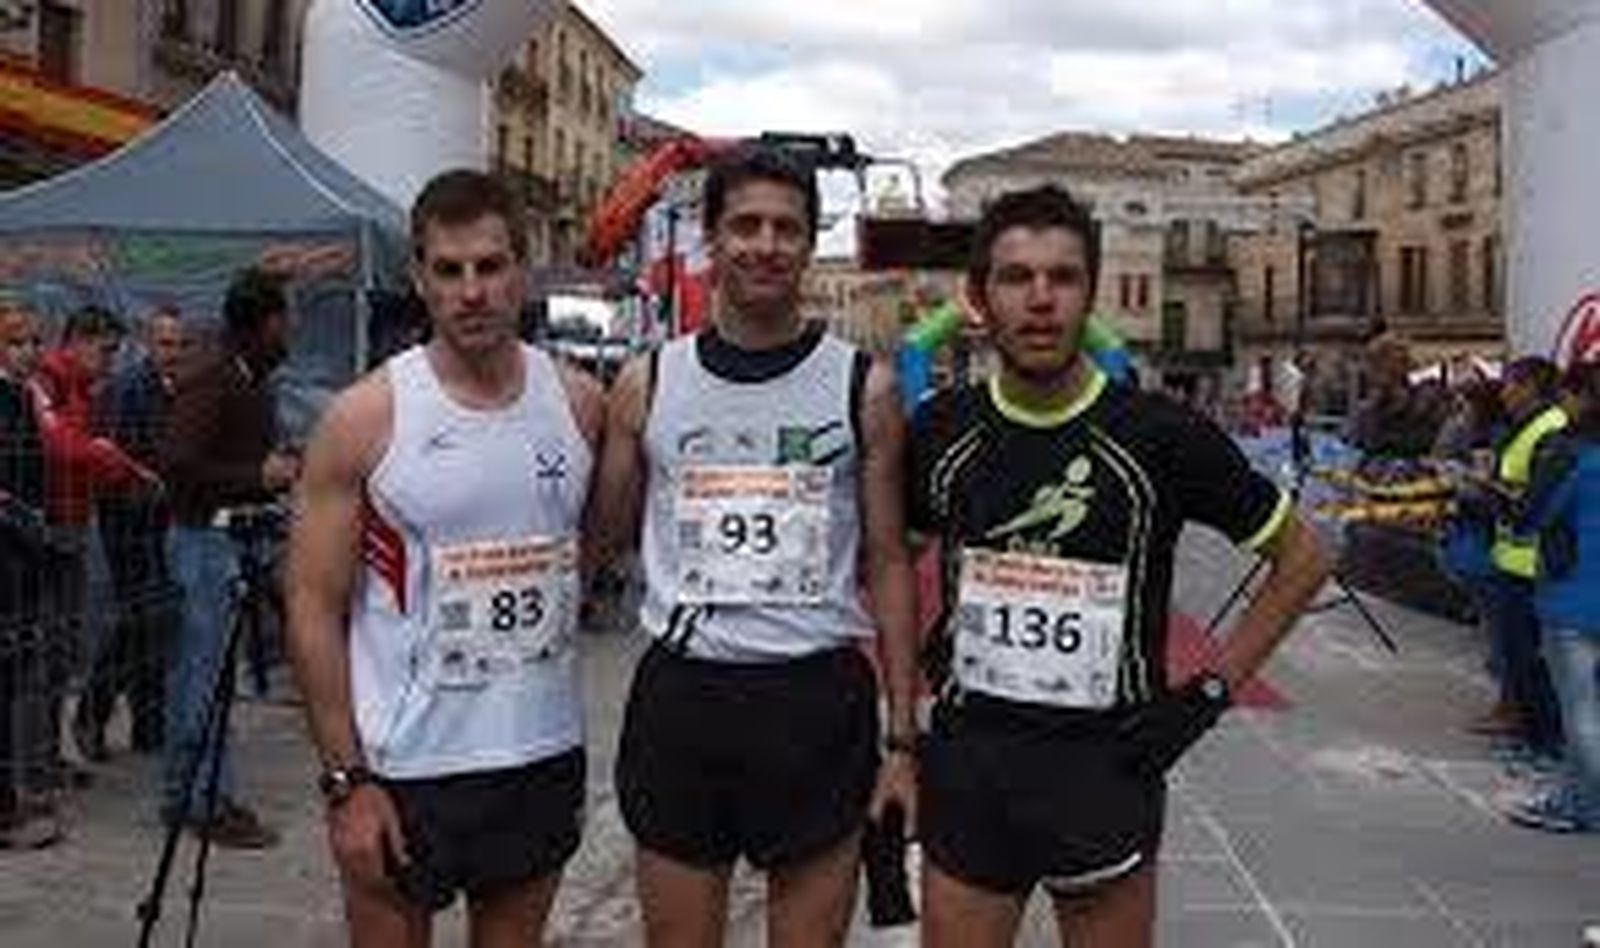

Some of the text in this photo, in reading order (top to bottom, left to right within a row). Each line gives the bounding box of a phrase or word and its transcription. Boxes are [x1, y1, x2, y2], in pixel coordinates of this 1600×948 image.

[720, 513, 778, 553] 93
[492, 586, 544, 631] 83
[990, 604, 1081, 654] 136
